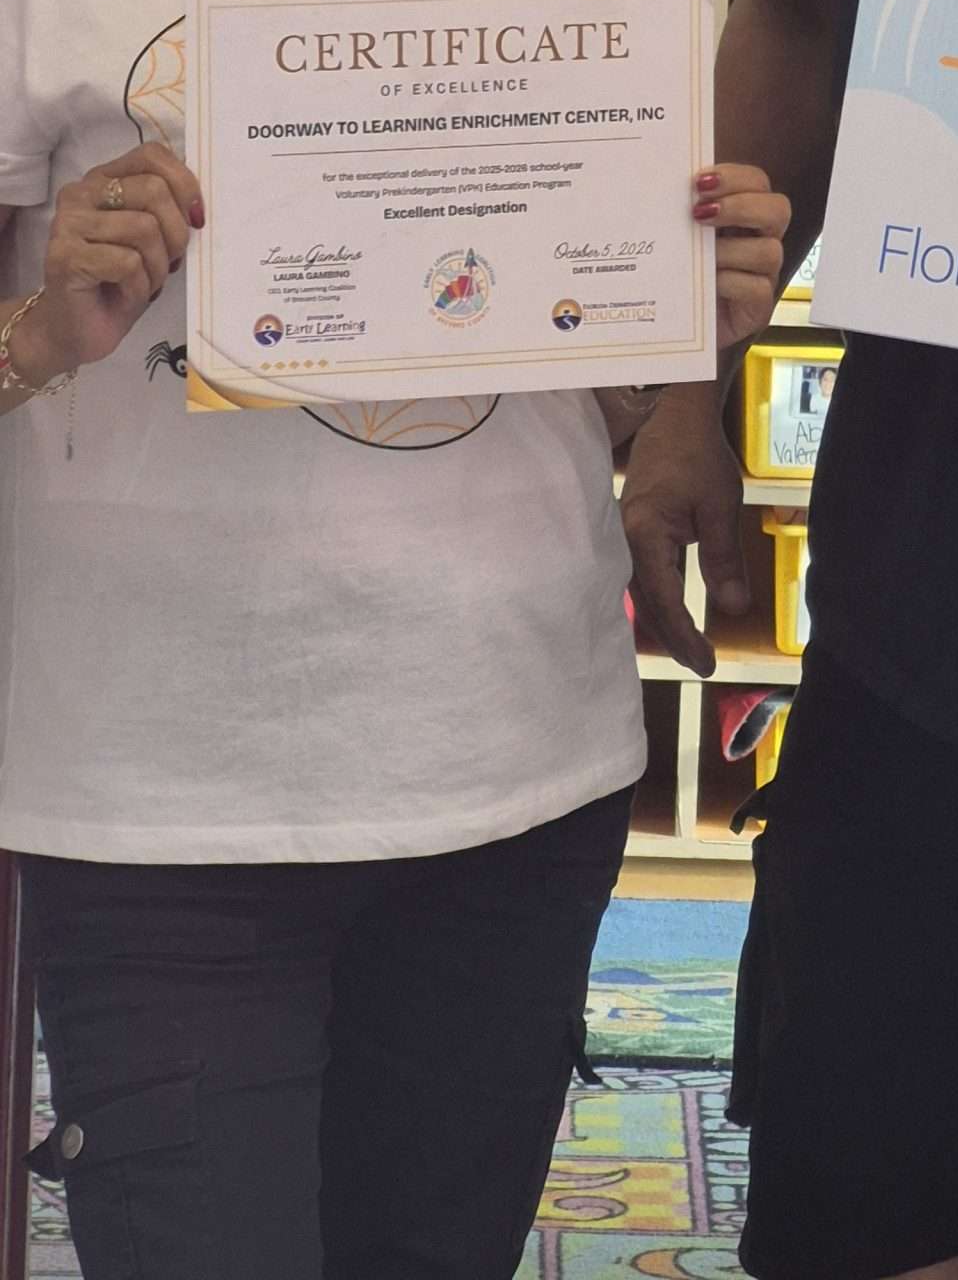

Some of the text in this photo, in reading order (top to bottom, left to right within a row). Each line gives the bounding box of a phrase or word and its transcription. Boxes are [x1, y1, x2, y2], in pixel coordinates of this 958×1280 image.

[275, 21, 630, 74] CERTIFICATE
[380, 78, 529, 97] OF EXCELLENCE
[247, 107, 665, 140] DOORWAY TO LEARNING ENRICHMENT CENTER, INC
[322, 173, 336, 182] for
[338, 172, 354, 182] the
[356, 170, 409, 181] exceptional
[410, 168, 448, 179] delivery
[449, 167, 460, 176] of
[460, 166, 477, 175] the
[335, 189, 380, 199] Voluntary
[485, 181, 531, 192] Education
[532, 179, 572, 190] Program
[384, 200, 528, 220] Excellent Designation
[617, 240, 656, 256] 2026
[273, 272, 304, 282] LAURA
[572, 266, 593, 275] DATE
[316, 320, 366, 336] Learning
